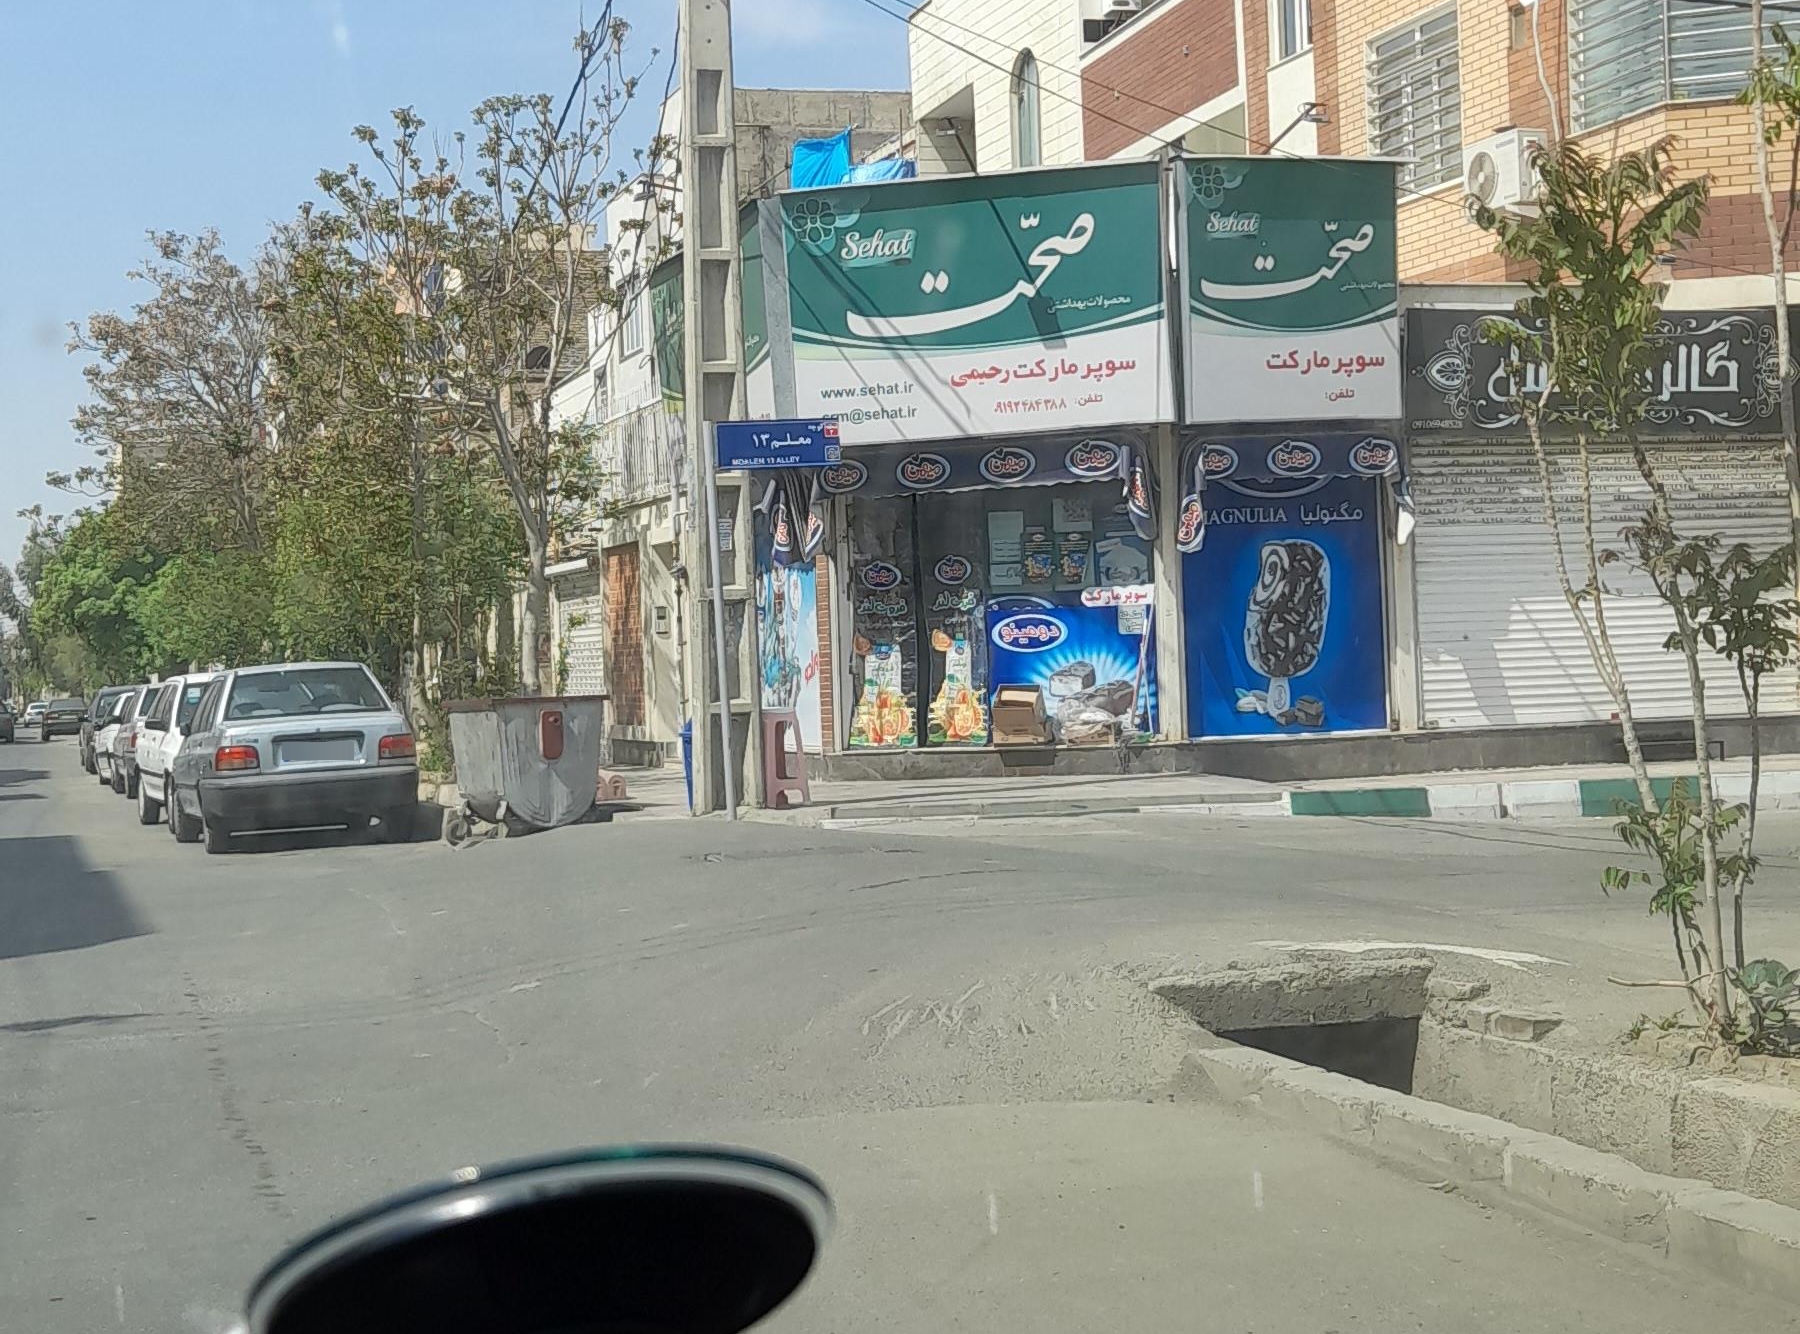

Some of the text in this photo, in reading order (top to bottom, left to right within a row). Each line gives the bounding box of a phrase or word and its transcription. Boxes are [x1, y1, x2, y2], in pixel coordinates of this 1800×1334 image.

[1207, 211, 1258, 233] Sehat
[840, 228, 912, 260] Sehat
[1086, 295, 1131, 309] محصولات
[950, 358, 1137, 387] سوپر مارکت رحیمی
[1266, 350, 1385, 377] سوپر مارکت
[821, 381, 914, 399] www.sehat.ir
[752, 432, 812, 450] معلم ۱۳
[988, 455, 1028, 475] میهن
[1074, 449, 1115, 468] میهن
[1275, 451, 1314, 470] میهن
[905, 461, 943, 481] میهن
[1300, 501, 1363, 526] مگنولیا
[1001, 622, 1060, 644] دومینو
